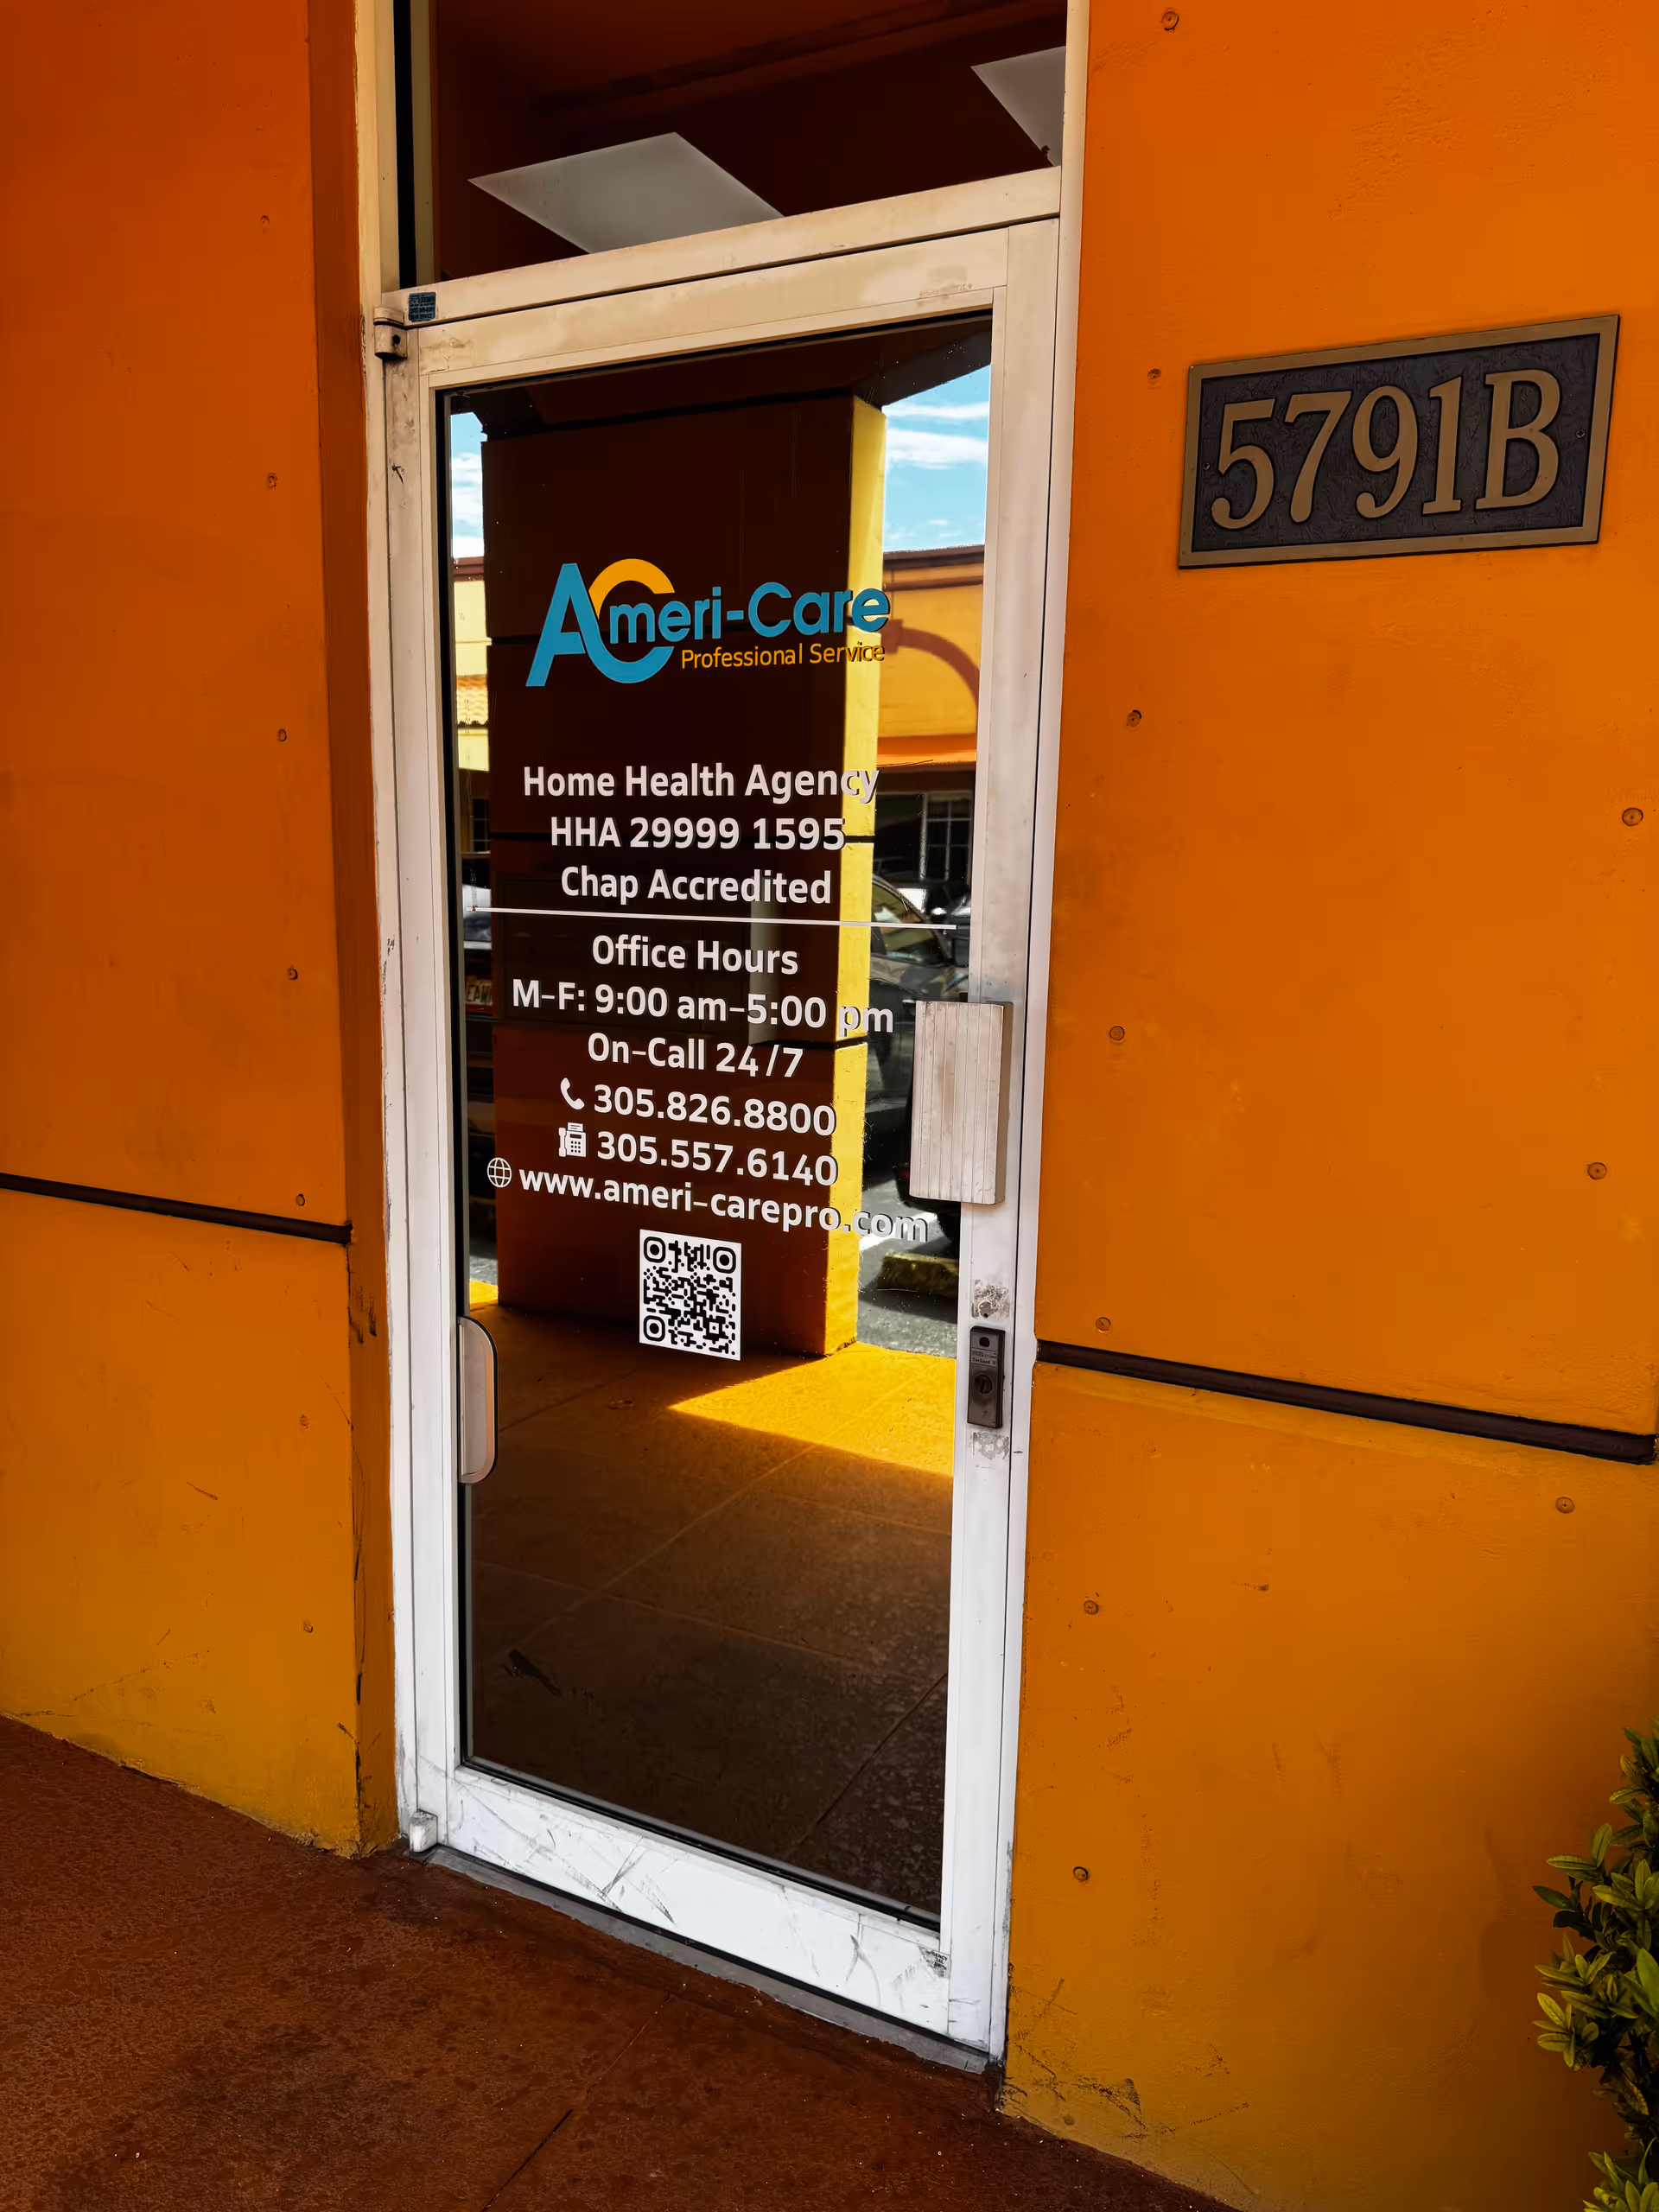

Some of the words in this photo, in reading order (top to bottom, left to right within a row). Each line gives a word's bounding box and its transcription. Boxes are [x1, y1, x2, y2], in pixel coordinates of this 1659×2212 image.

[1211, 369, 1560, 529] 5791B
[682, 643, 803, 669] Professional
[810, 643, 885, 664] Service
[524, 766, 615, 797] Home
[626, 762, 734, 797] Health
[744, 764, 880, 804] Agency
[550, 817, 621, 848] HHA
[630, 817, 740, 849] 29999
[753, 817, 845, 850] 1595
[561, 865, 639, 906] Chap
[647, 869, 831, 904] Accredited
[592, 935, 686, 969] Office
[697, 940, 798, 975] Hours
[595, 983, 668, 1018] 9:00
[838, 1007, 893, 1039] pm
[588, 1032, 705, 1071] On-Call
[715, 1042, 804, 1077] 24/7
[594, 1084, 836, 1136] 305.826.8800
[597, 1130, 837, 1186] 305.557.6140
[518, 1169, 928, 1243] www.ameri-carepro.com
